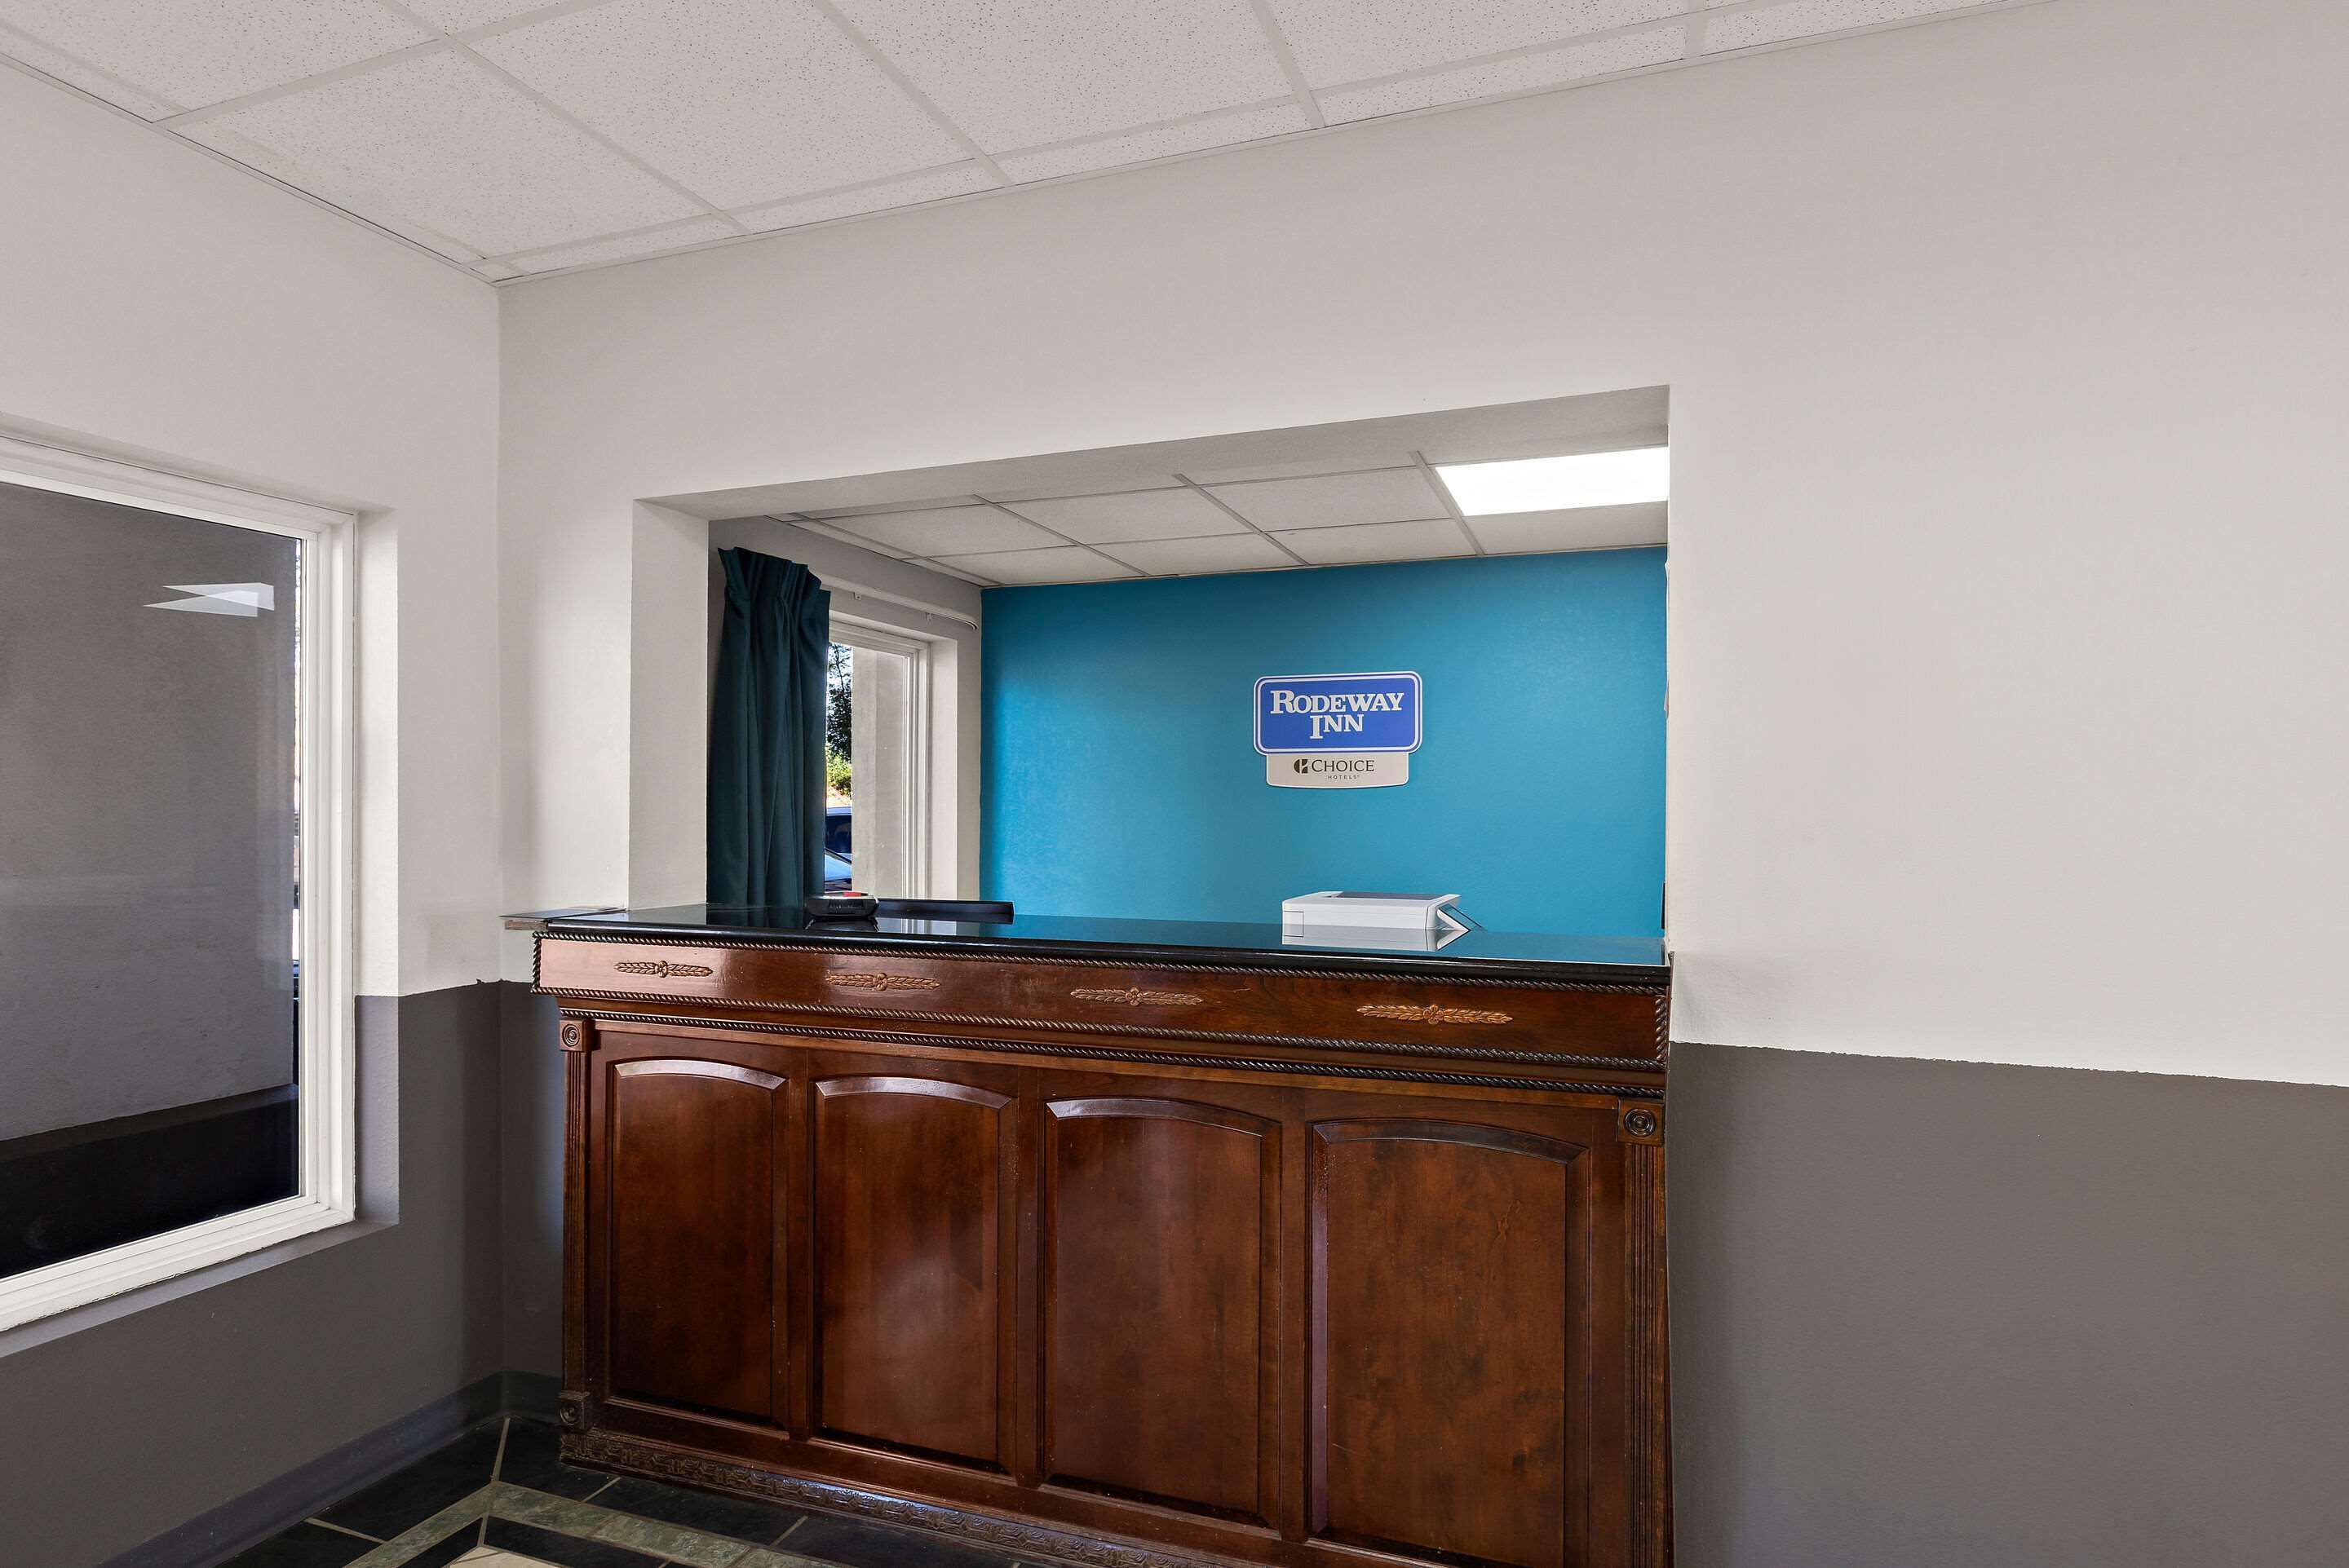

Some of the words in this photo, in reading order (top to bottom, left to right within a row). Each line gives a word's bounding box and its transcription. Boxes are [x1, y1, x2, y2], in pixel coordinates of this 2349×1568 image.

[1270, 690, 1405, 714] RODEWAY
[1309, 714, 1365, 740] INN
[1311, 759, 1375, 772] CHOICE
